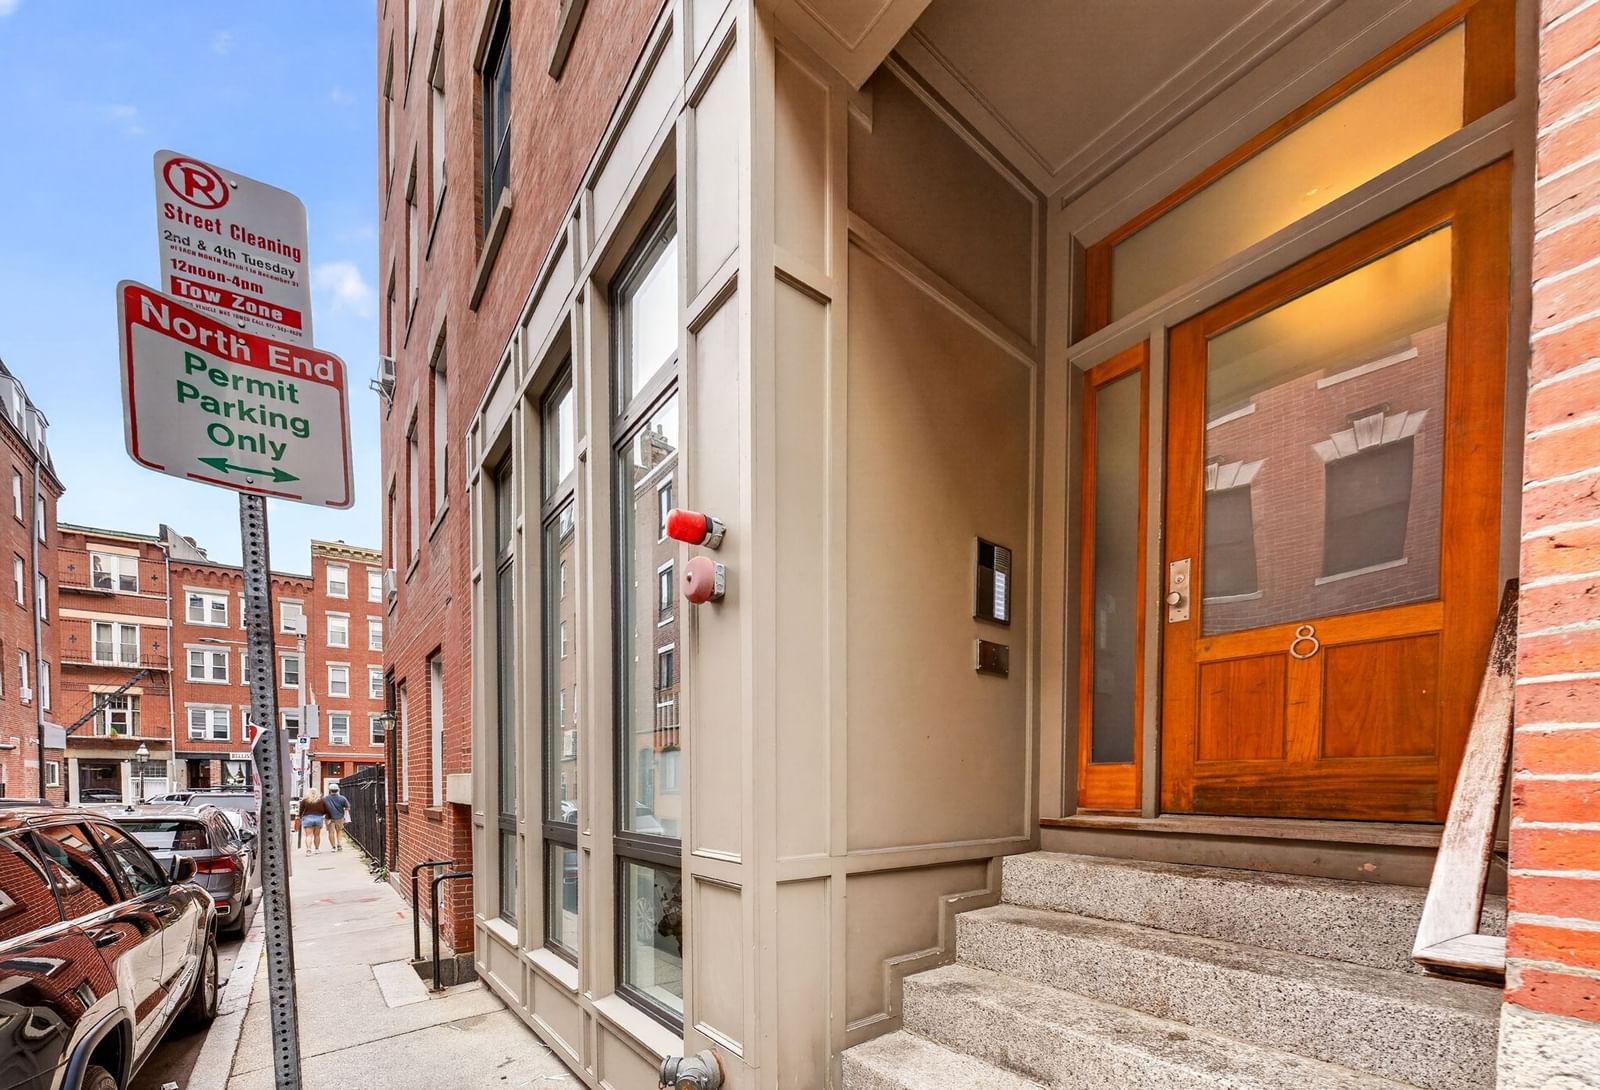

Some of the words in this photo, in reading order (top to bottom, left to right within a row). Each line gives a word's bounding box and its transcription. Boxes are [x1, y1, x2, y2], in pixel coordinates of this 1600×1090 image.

[164, 203, 222, 235] Street
[230, 223, 301, 263] Cleaning
[164, 230, 191, 247] 2nd
[197, 239, 207, 251] &
[214, 245, 236, 260] 4th
[241, 252, 295, 279] Tuesday
[170, 258, 263, 294] 12noon-4pm
[176, 279, 221, 304] Tow
[231, 294, 283, 321] Zone
[195, 303, 216, 313] VEHICLE
[251, 318, 265, 327] CALL
[140, 294, 251, 362] North
[268, 344, 335, 382] End
[184, 351, 300, 404] Permit
[176, 379, 310, 438] Parking
[206, 422, 287, 461] Only
[1290, 624, 1321, 660] 8
